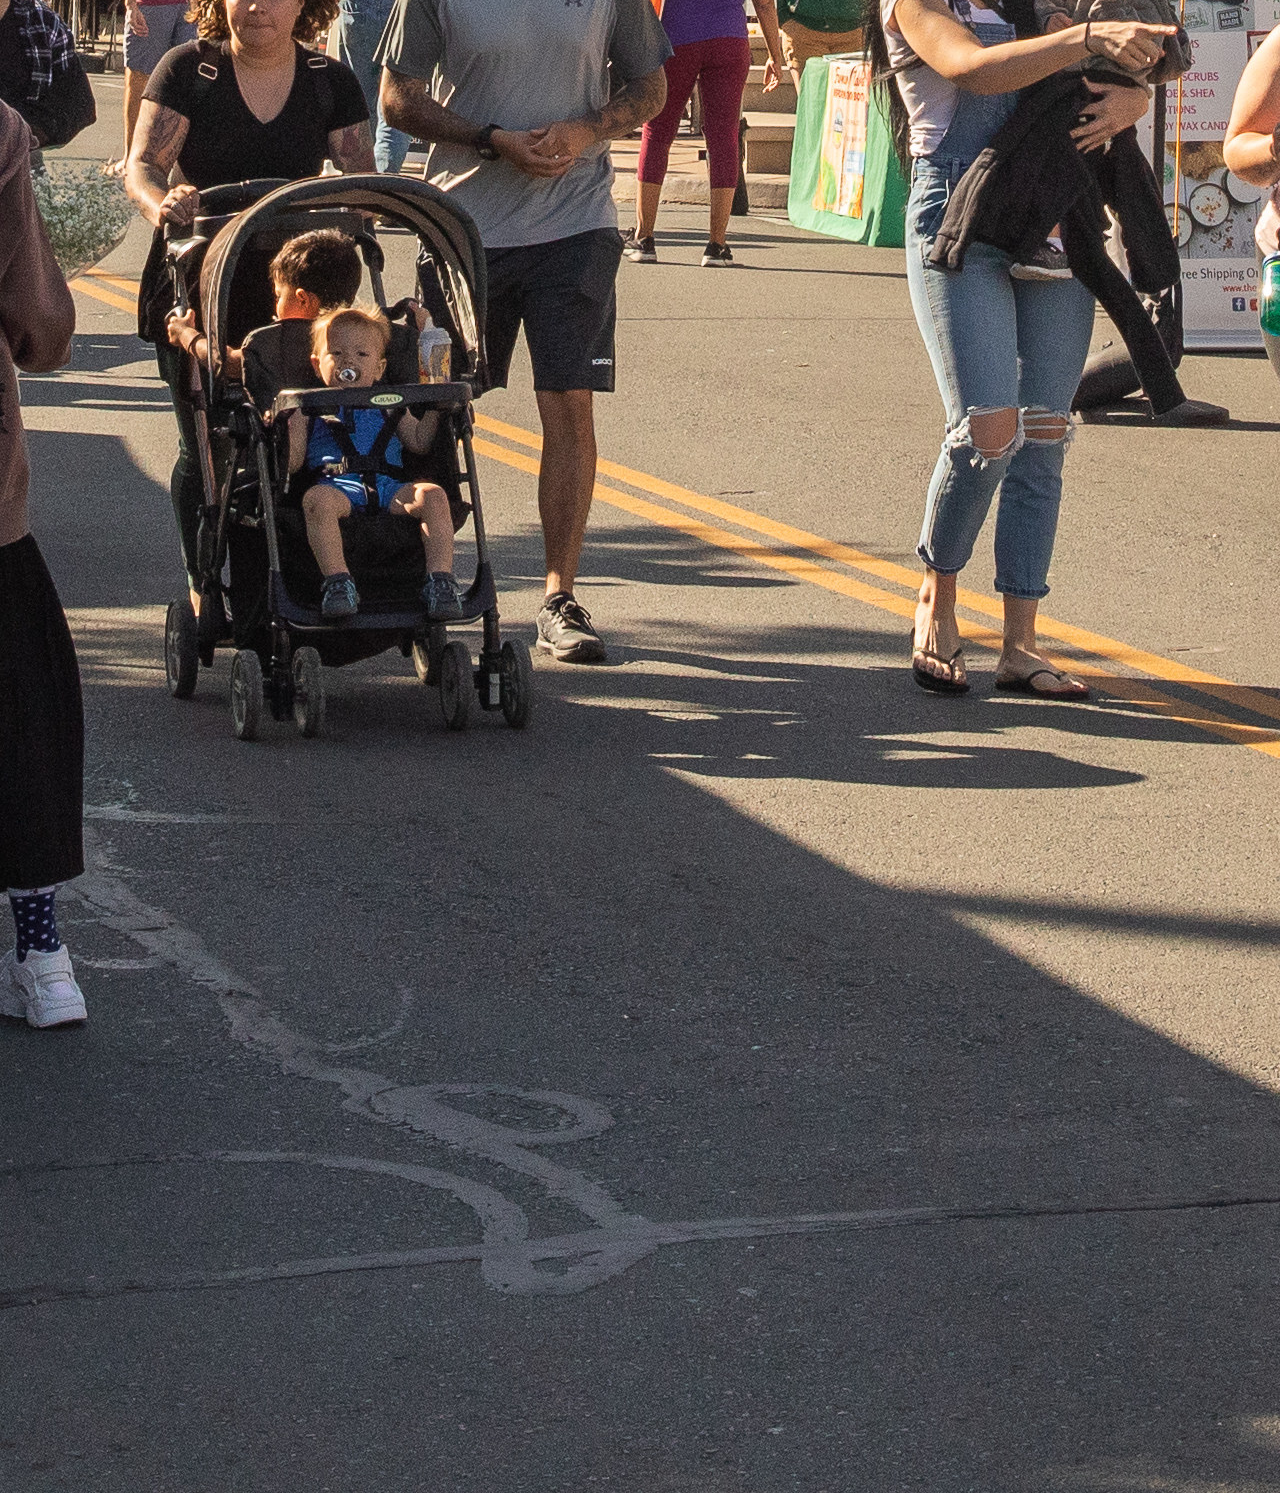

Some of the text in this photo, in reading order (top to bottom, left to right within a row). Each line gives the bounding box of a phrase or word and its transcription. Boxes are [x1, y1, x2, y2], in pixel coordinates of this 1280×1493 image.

[1182, 71, 1219, 82] SCRUBS
[1189, 88, 1216, 98] SHEA
[1200, 121, 1228, 131] CAND
[1181, 269, 1198, 280] ree
[1200, 267, 1245, 281] Shipping
[1222, 282, 1257, 292] www.the
